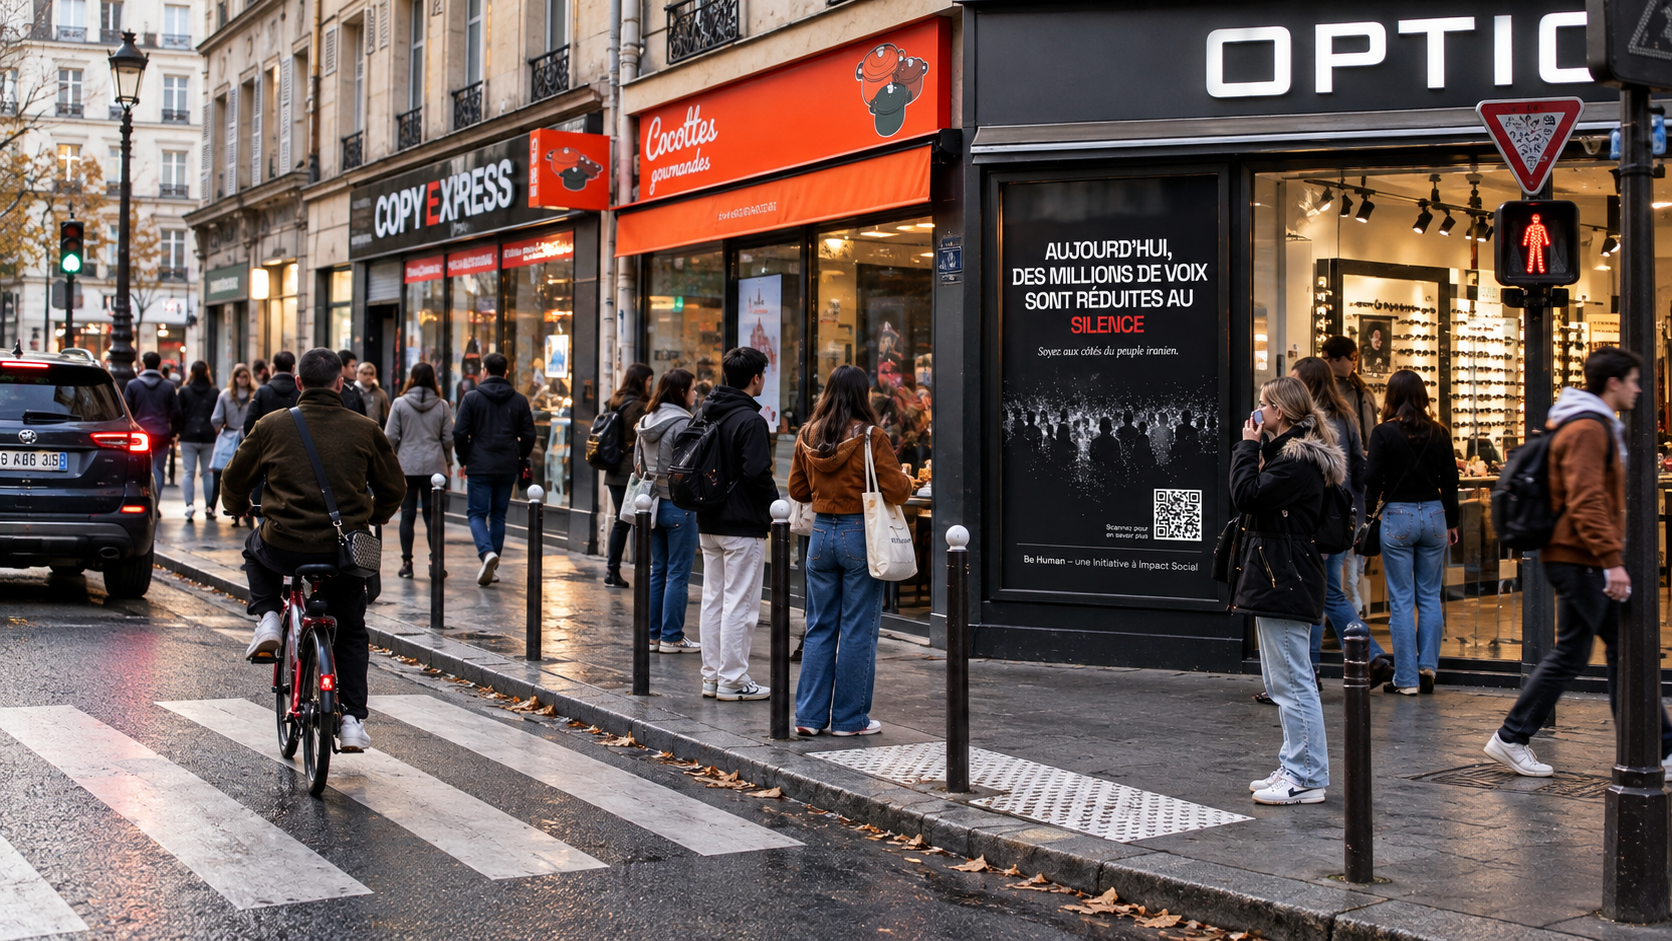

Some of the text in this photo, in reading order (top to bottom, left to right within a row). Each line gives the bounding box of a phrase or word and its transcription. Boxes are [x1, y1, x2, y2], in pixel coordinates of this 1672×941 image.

[646, 105, 718, 162] Cocottes
[649, 147, 711, 196] gourmandes
[1045, 239, 1172, 261] AUJOURD’HUI,
[1012, 263, 1208, 286] DES MILLIONS DE VOIX
[1025, 286, 1194, 310] SONT RÉDUITES AU
[1071, 315, 1145, 334] SILENCE
[1038, 345, 1179, 359] Soyez aux côtés du peuple iranien.
[1105, 523, 1132, 532] Scannez
[1023, 555, 1035, 564] Be
[1036, 556, 1066, 565] Human
[1074, 559, 1091, 567] une
[1092, 558, 1130, 569] Initiative
[1131, 559, 1138, 569] à
[1138, 560, 1169, 571] Impact
[1171, 561, 1199, 572] Social
